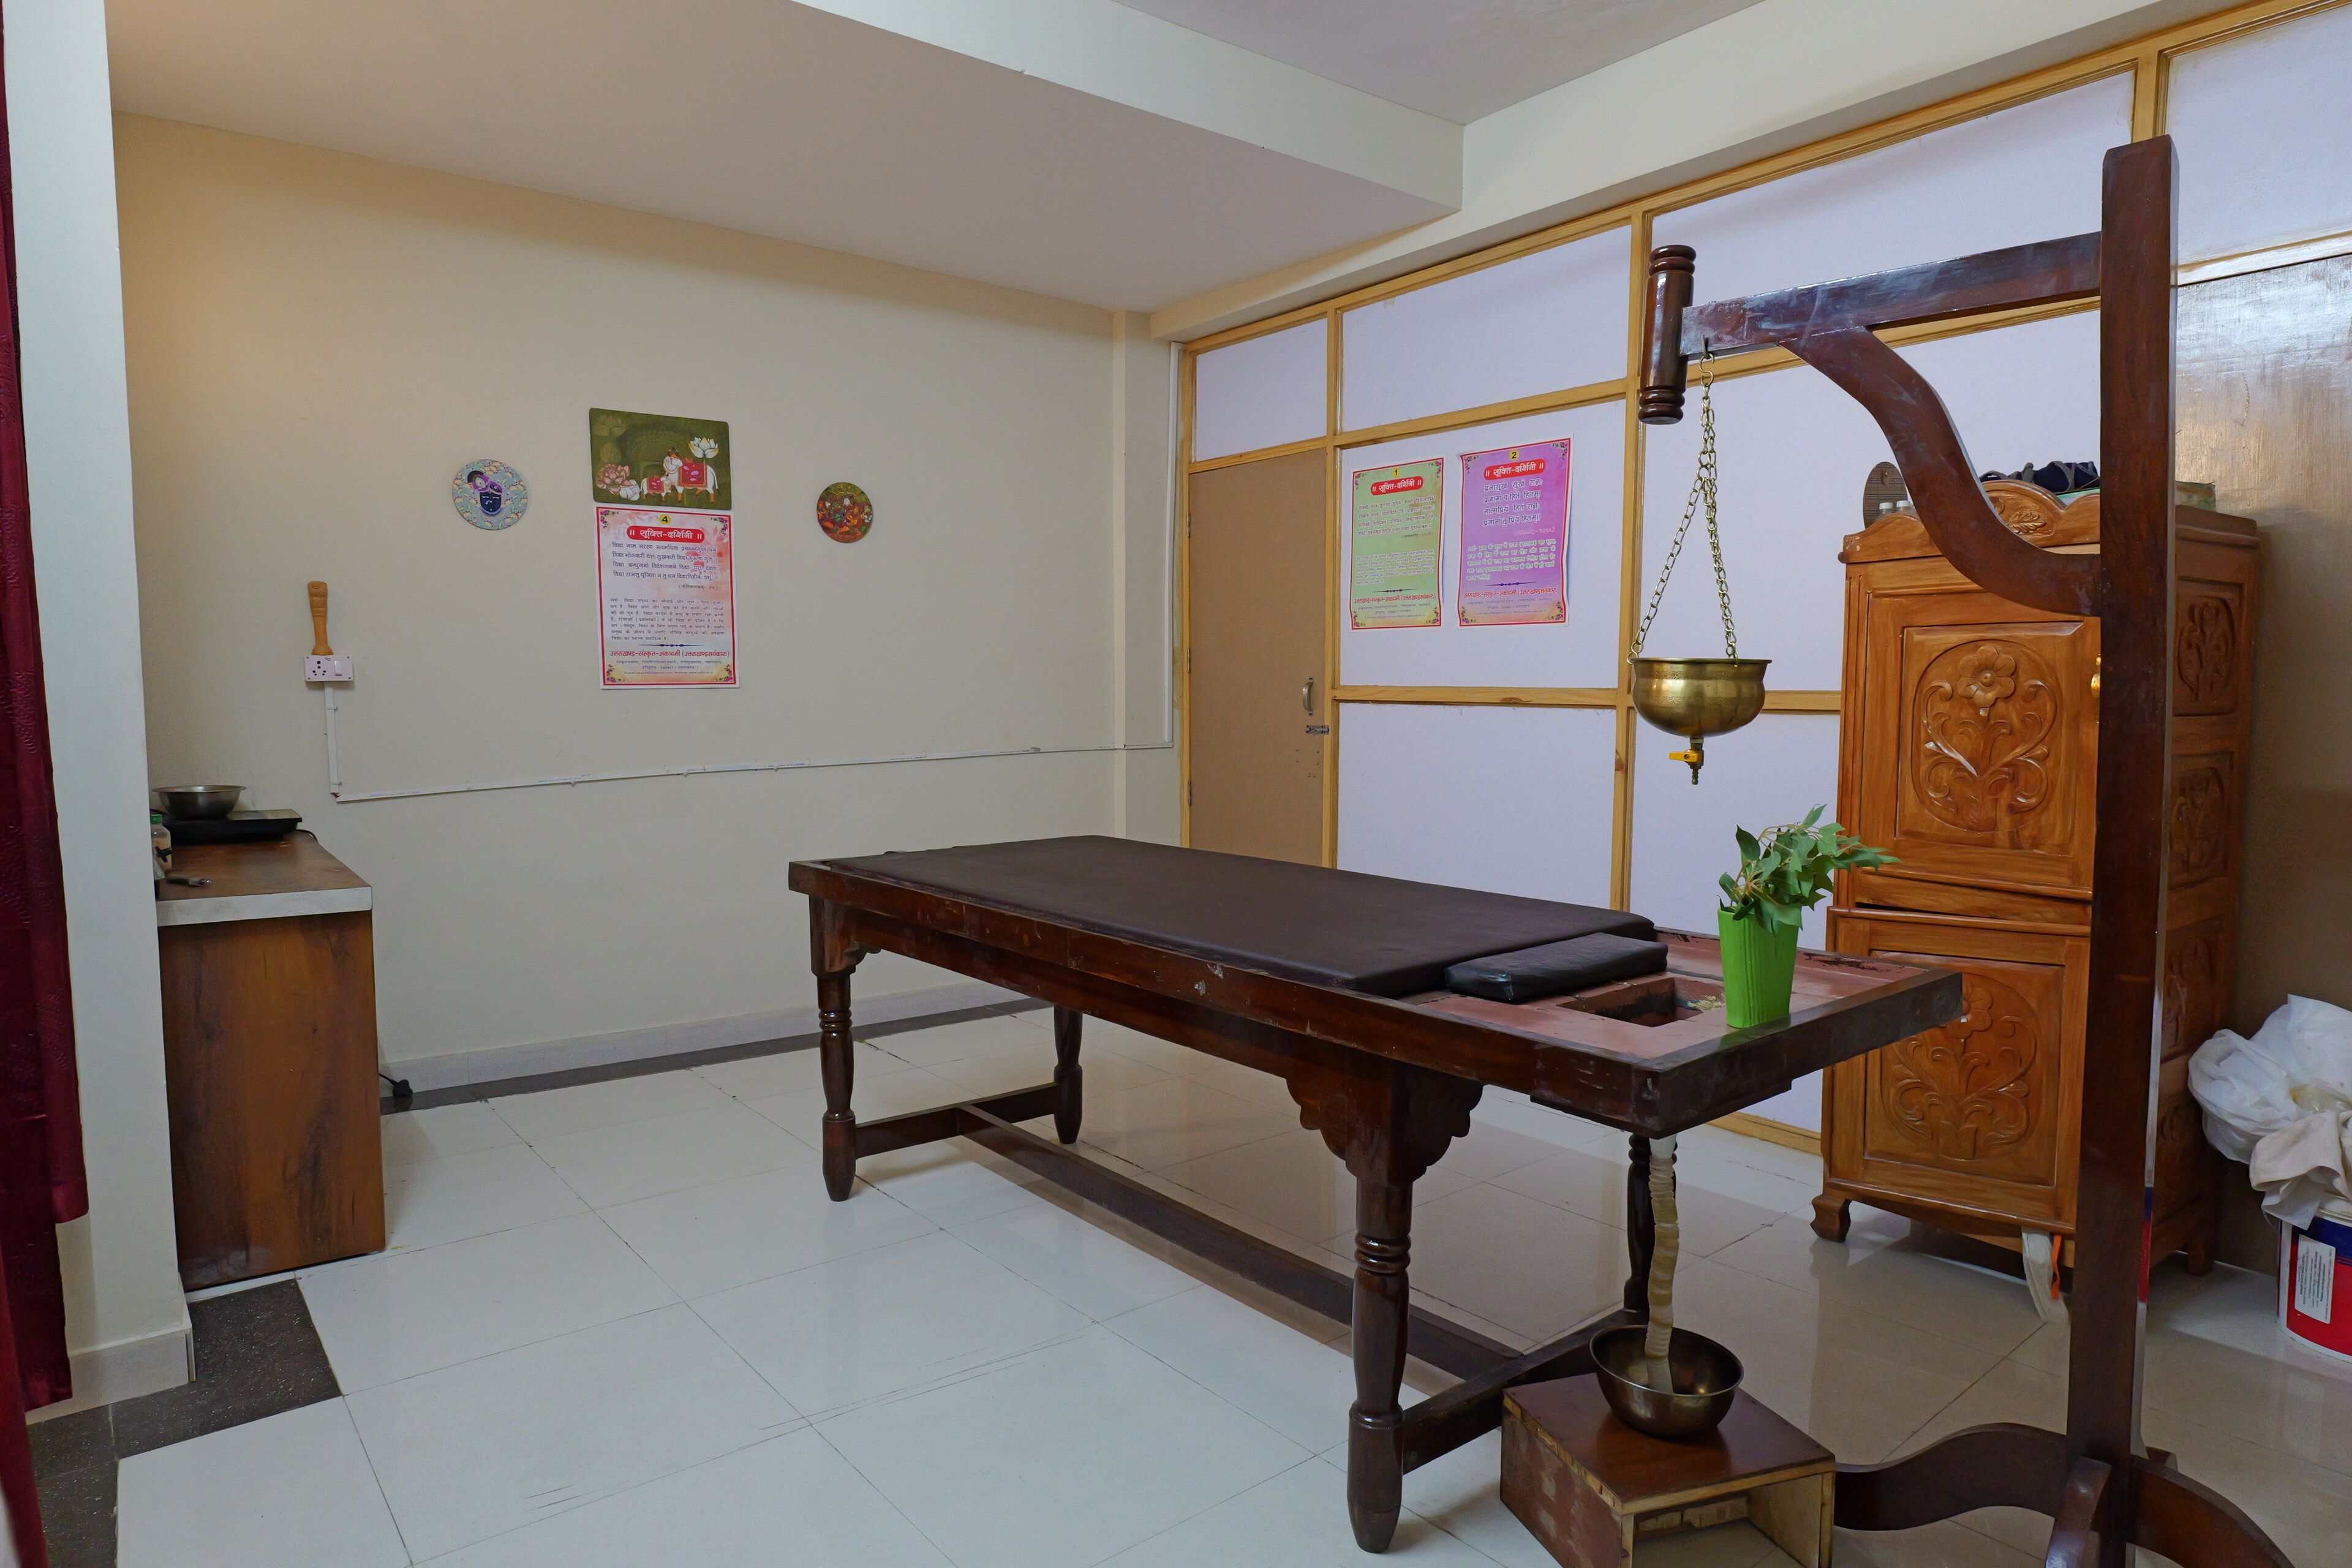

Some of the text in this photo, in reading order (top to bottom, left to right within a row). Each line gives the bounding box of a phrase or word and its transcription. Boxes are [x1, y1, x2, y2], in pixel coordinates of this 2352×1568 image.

[1493, 462, 1536, 478] सूक्ति-दर्शिनी
[1379, 478, 1415, 493] सूक्ति-दर्शिनी
[1484, 481, 1507, 492] प्रजासुखे
[1513, 480, 1524, 489] सुखं
[1484, 495, 1502, 503] प्रजानां
[1510, 491, 1520, 500] हिते
[1483, 518, 1501, 527] प्रजानां
[640, 528, 693, 540] सूक्ति-दर्शिनी
